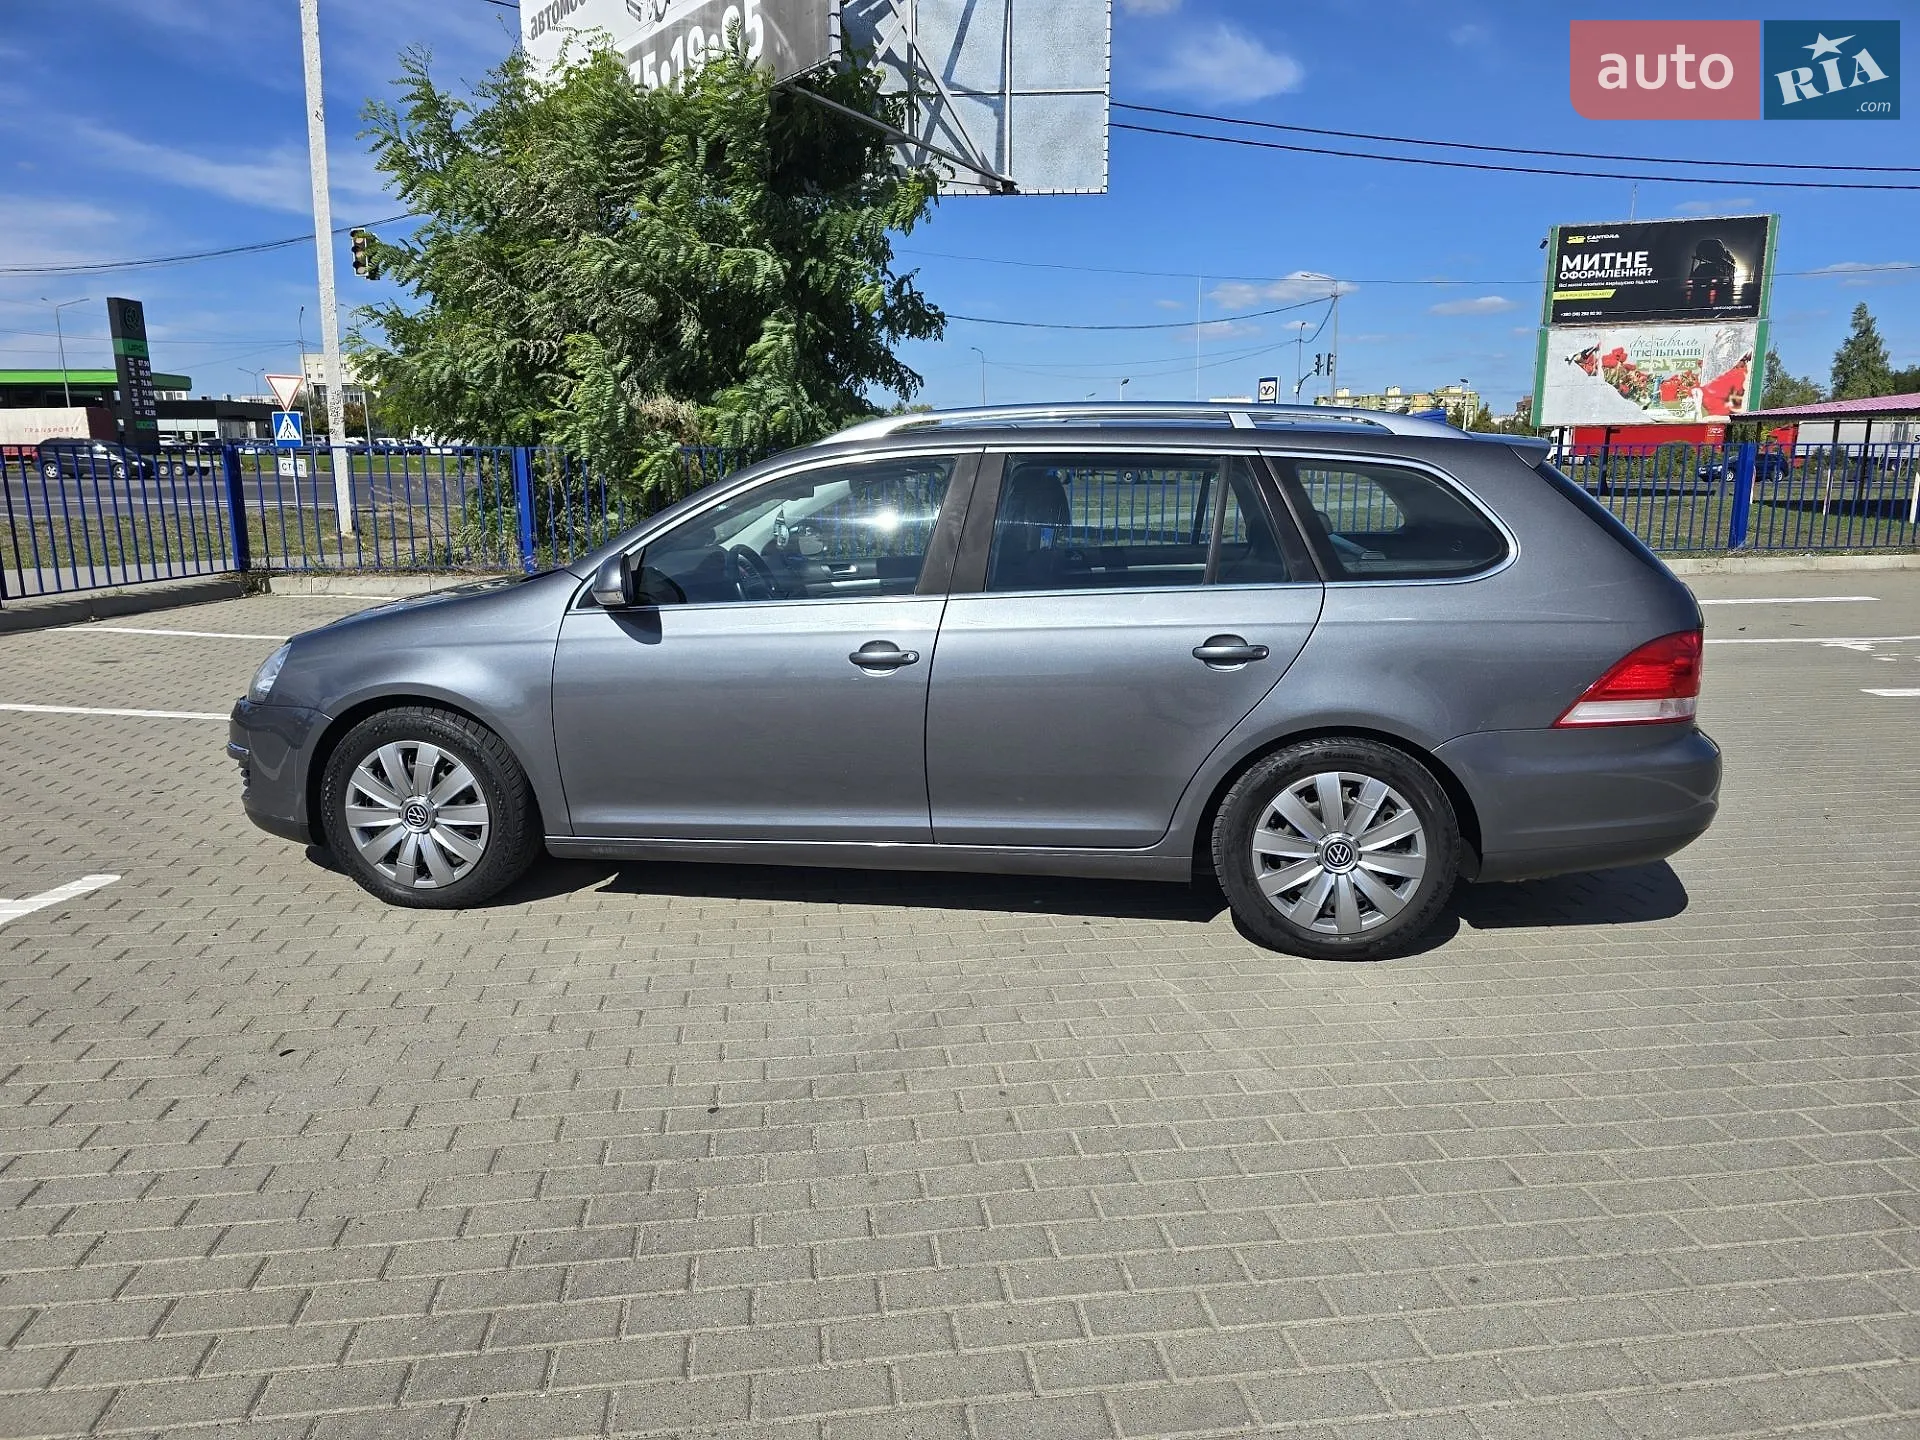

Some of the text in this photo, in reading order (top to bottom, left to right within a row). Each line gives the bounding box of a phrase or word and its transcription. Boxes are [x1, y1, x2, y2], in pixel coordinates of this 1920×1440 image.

[531, 0, 585, 40] автомо
[1562, 251, 1649, 271] МИТНЕ
[1560, 268, 1653, 280] ОФОРМЛЕННЯ?
[281, 462, 305, 474] СТП
